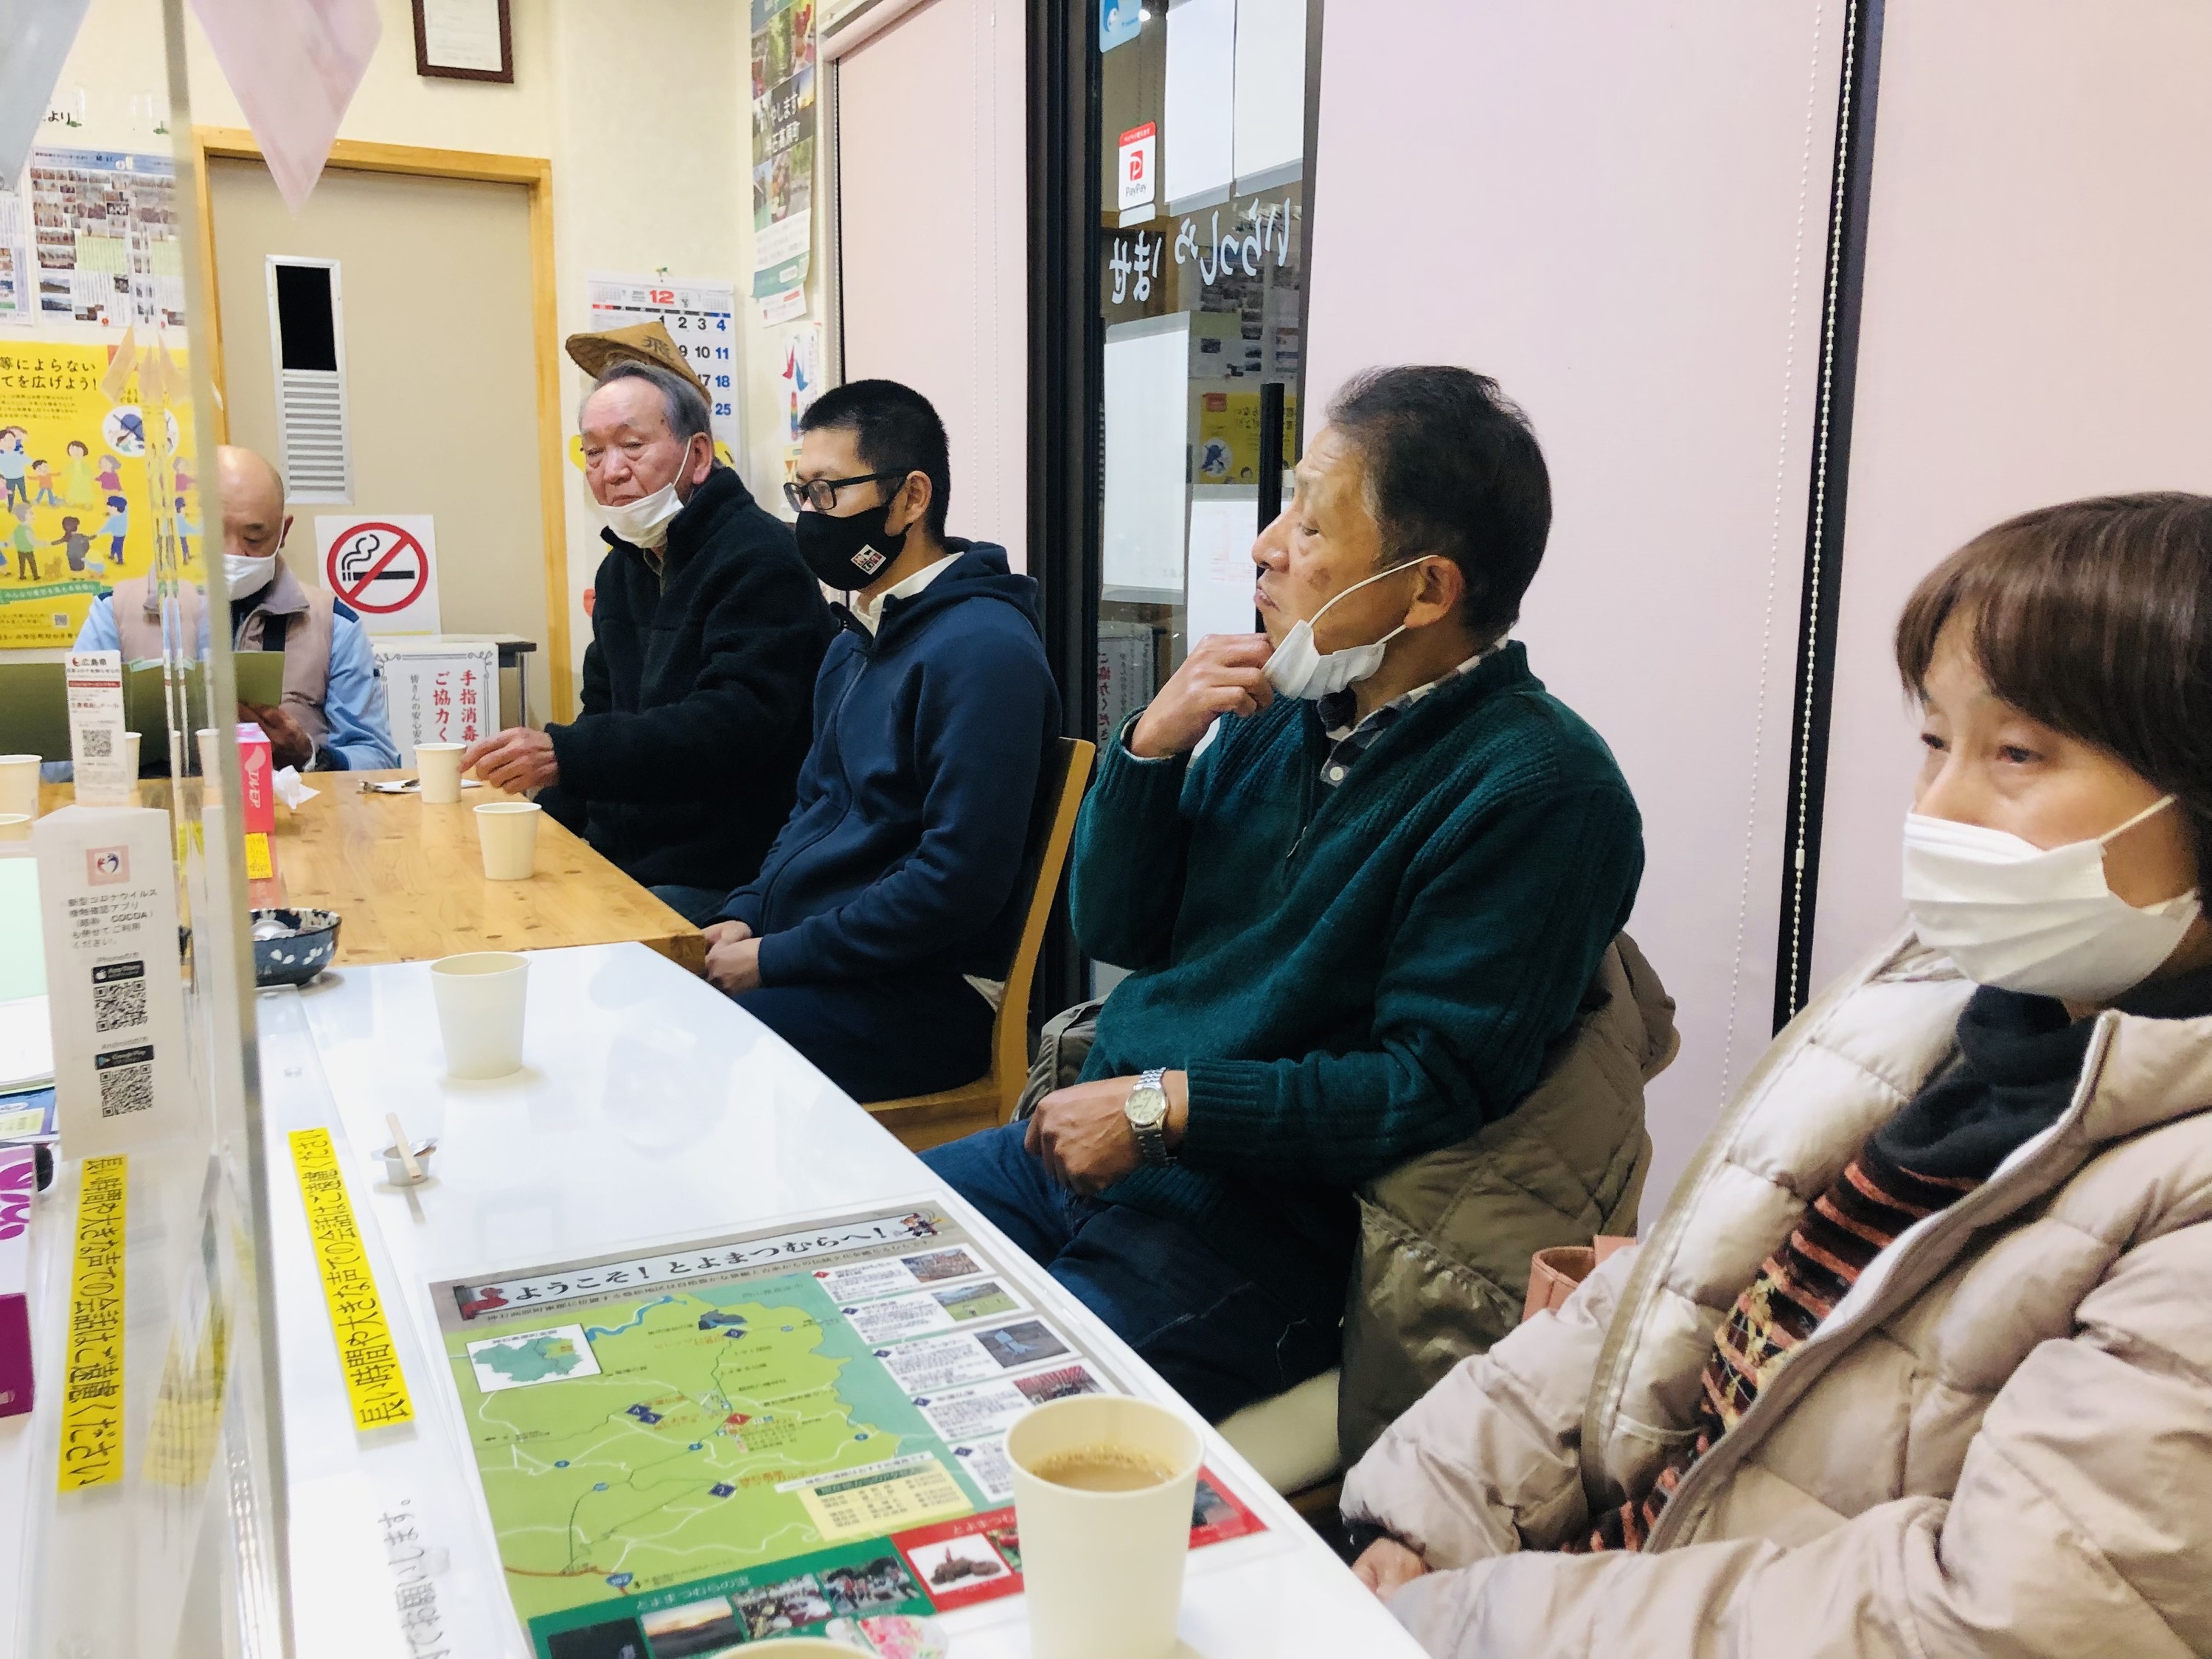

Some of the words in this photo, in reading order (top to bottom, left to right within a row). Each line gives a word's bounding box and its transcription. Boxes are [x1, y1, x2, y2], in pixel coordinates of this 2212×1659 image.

[1125, 183, 1147, 198] PayPay
[650, 290, 674, 304] 12
[678, 317, 687, 328] 2
[698, 318, 706, 330] 3
[717, 319, 726, 331] 4
[695, 346, 710, 358] 10
[715, 347, 728, 359] 11
[0, 356, 96, 372] 等によらない
[715, 375, 730, 387] 18
[715, 403, 731, 415] 25
[433, 671, 451, 742] ご協力く
[460, 669, 479, 742] 手指消毒
[68, 888, 157, 907] 新型コロナウイルス
[378, 1498, 452, 1659] てお願いします。
